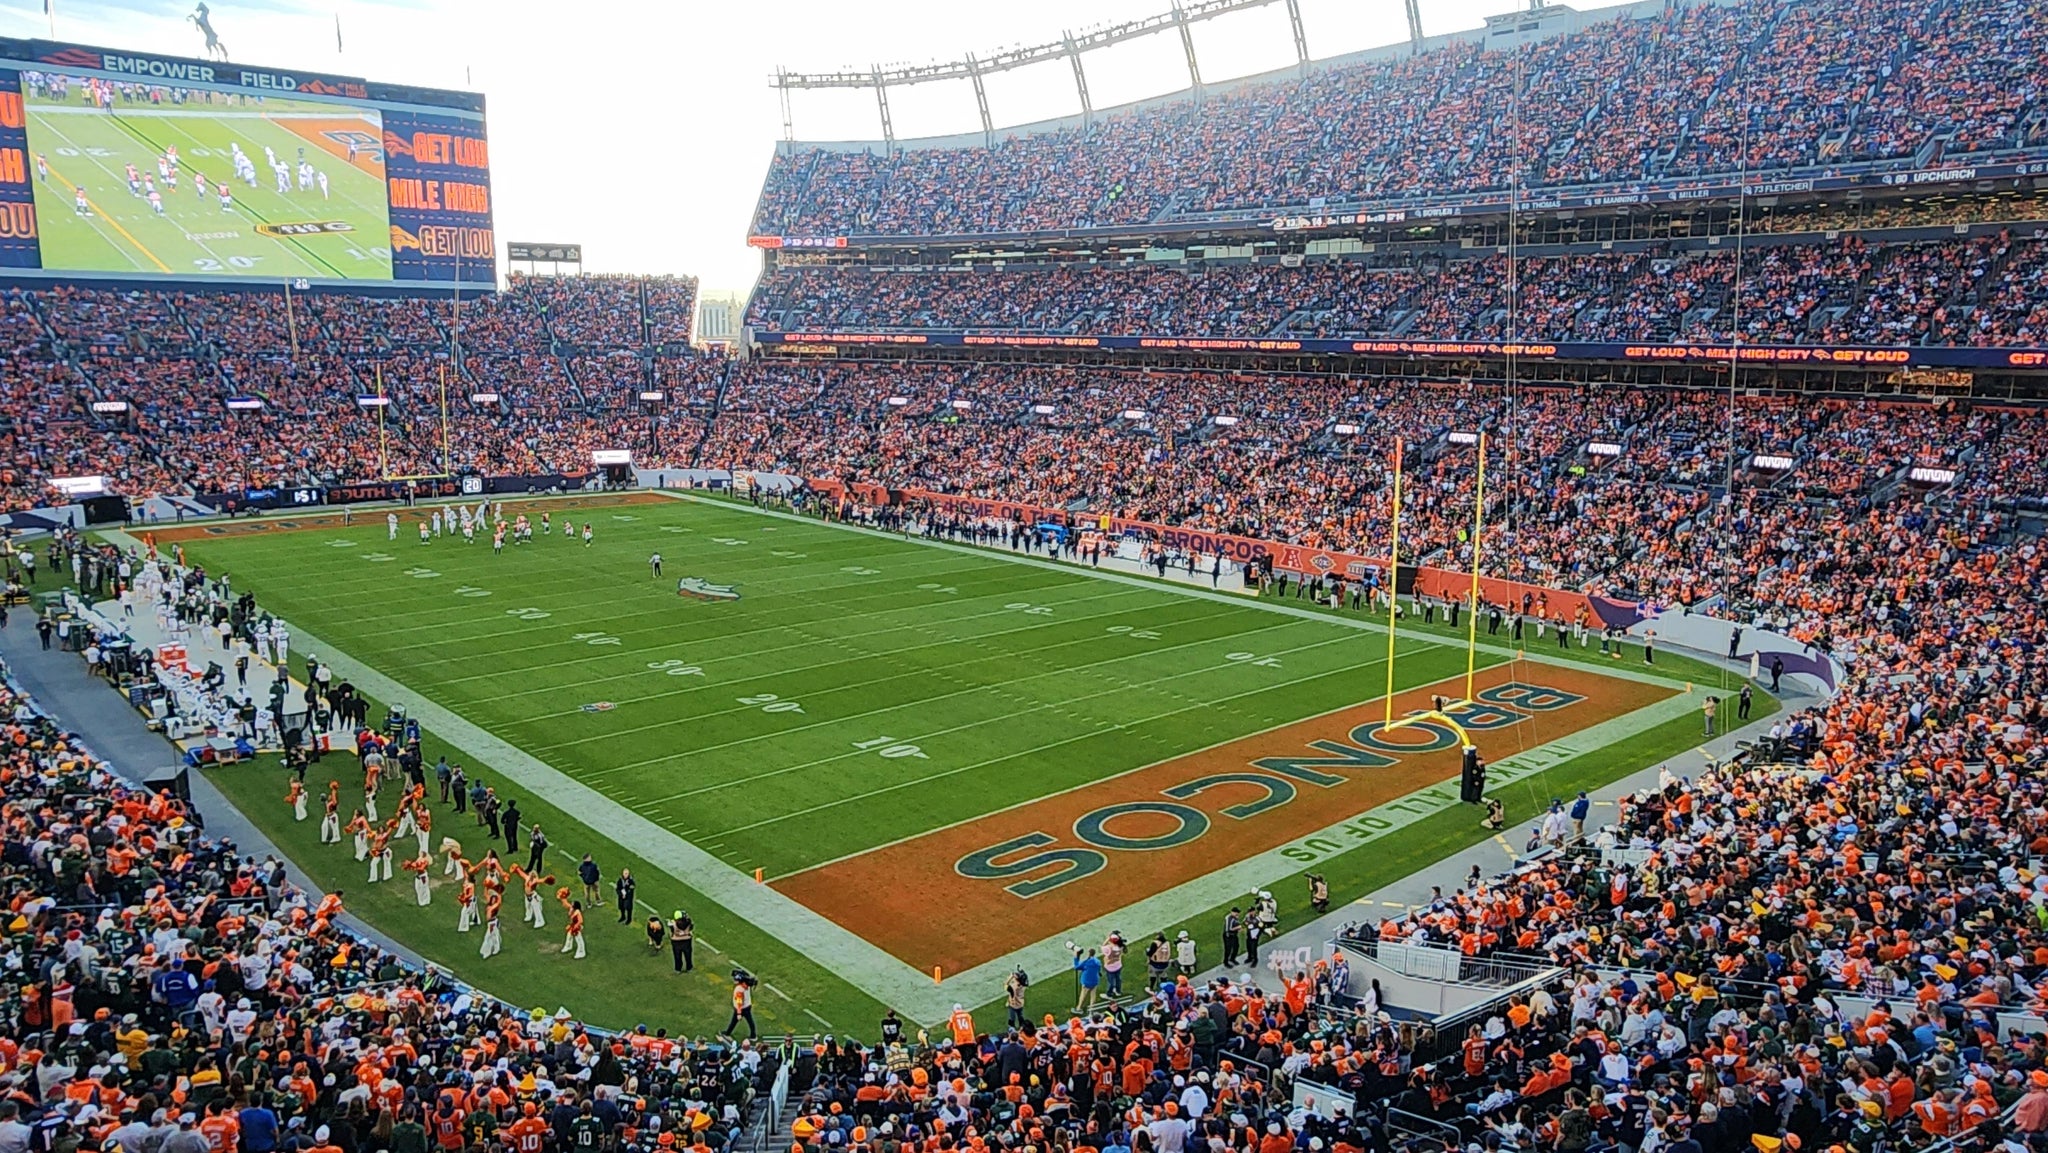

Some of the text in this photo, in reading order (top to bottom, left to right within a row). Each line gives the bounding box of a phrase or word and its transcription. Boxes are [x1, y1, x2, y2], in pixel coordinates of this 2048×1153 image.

[103, 54, 297, 91] EMPOWER FIELD
[413, 132, 452, 164] GET
[1914, 169, 1976, 182] UPCHURCH
[2030, 164, 2044, 172] 66
[390, 178, 488, 213] MILE HIGH
[1679, 190, 1709, 198] MILLER
[1754, 182, 1810, 194] 73 FLETCHER
[1532, 201, 1561, 209] THOMAS
[1603, 195, 1639, 204] MANNING
[1423, 209, 1453, 217] BOWLEN
[419, 225, 457, 256] GET
[1353, 343, 1556, 354] GET LOUD MILE HIGH CITY GET LOUD
[1625, 347, 1910, 362] GET LOUD MILE HIGH CITY GET LOUD
[2009, 353, 2045, 364] GET
[1164, 529, 1267, 561] BRONCOS
[572, 631, 618, 645] 40
[647, 659, 702, 675] 30
[736, 693, 800, 713] 20
[851, 736, 921, 758] 10
[954, 681, 1588, 899] BRONCOS
[1387, 788, 1455, 815] ALL
[1345, 816, 1393, 840] OF
[1279, 838, 1342, 863] US
[701, 1075, 717, 1087] 26
[1102, 1072, 1113, 1085] 10
[441, 1122, 454, 1134] 10
[1634, 1113, 1643, 1128] 2
[473, 1126, 483, 1142] 9
[578, 1131, 592, 1145] 10
[521, 1134, 538, 1150] 10
